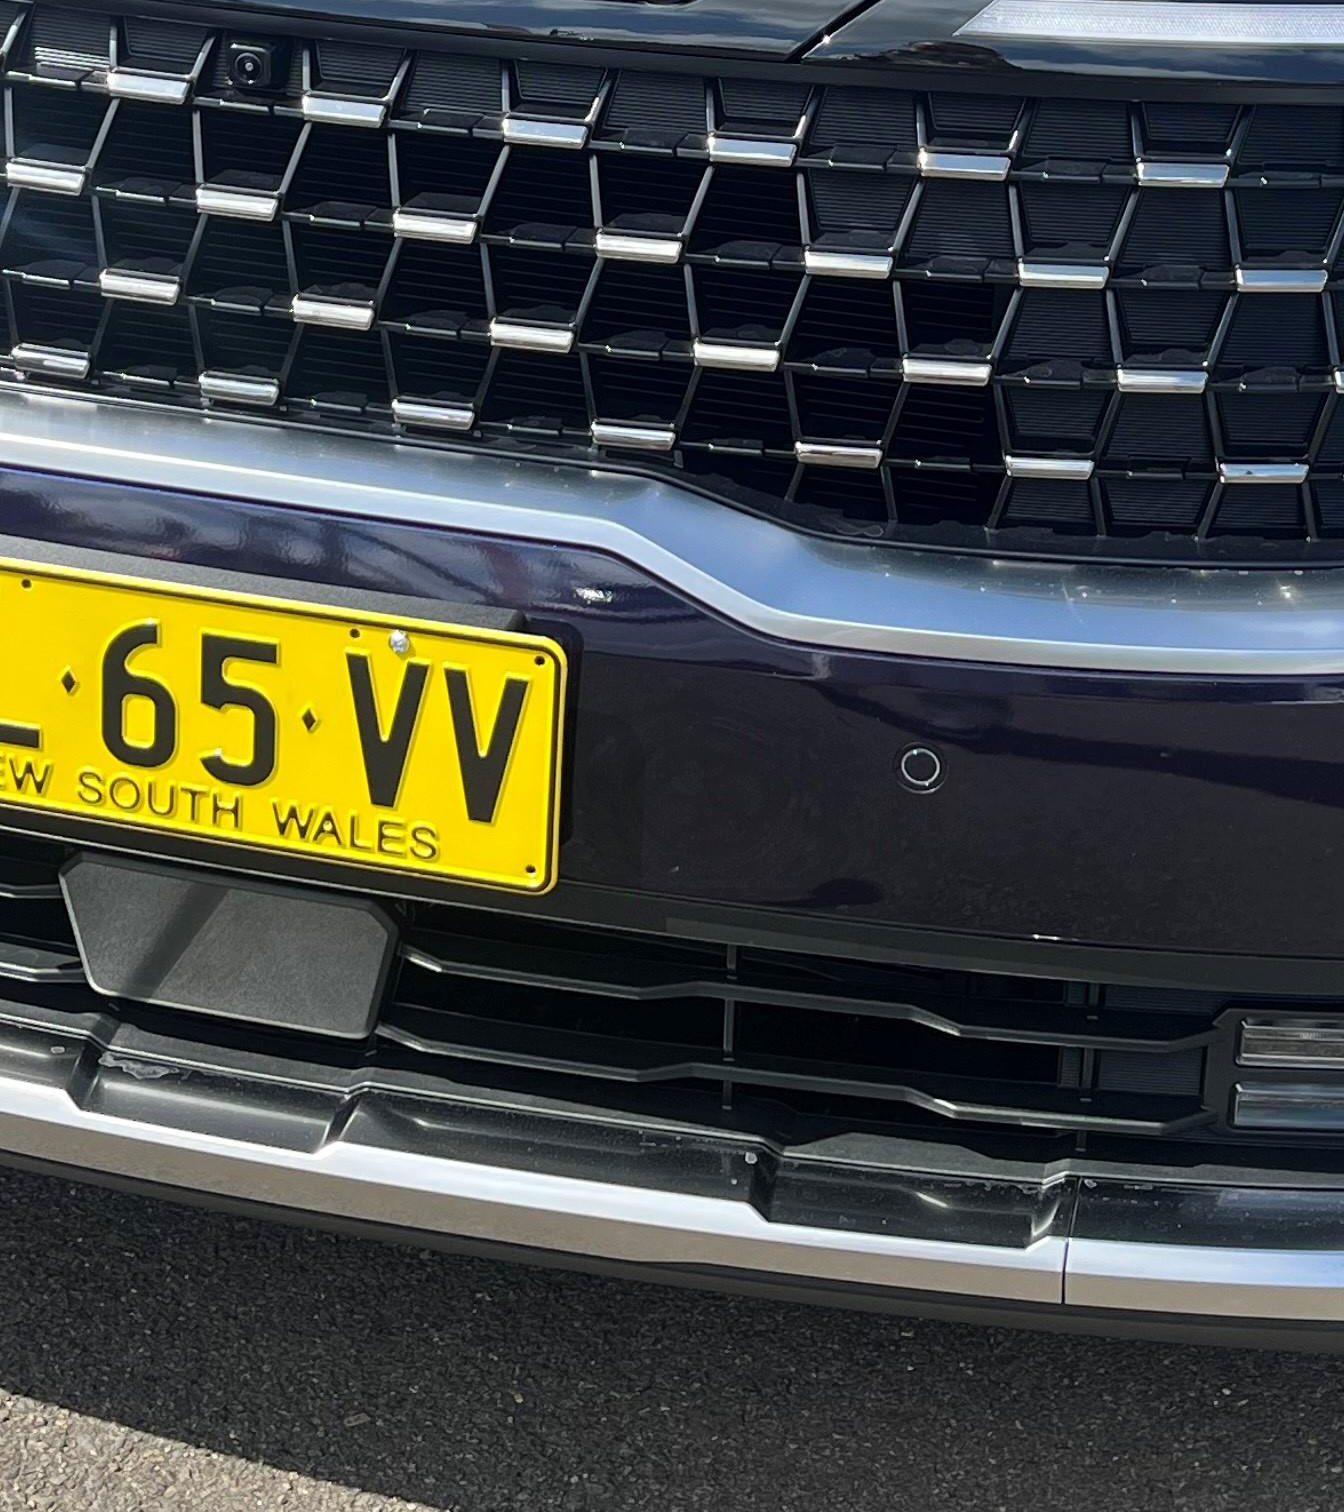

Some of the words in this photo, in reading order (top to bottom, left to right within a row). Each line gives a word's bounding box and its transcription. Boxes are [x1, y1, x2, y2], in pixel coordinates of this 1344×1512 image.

[101, 619, 278, 786] 65
[345, 651, 529, 824] VV
[78, 771, 240, 829] SOUTH
[273, 802, 440, 861] WALES
